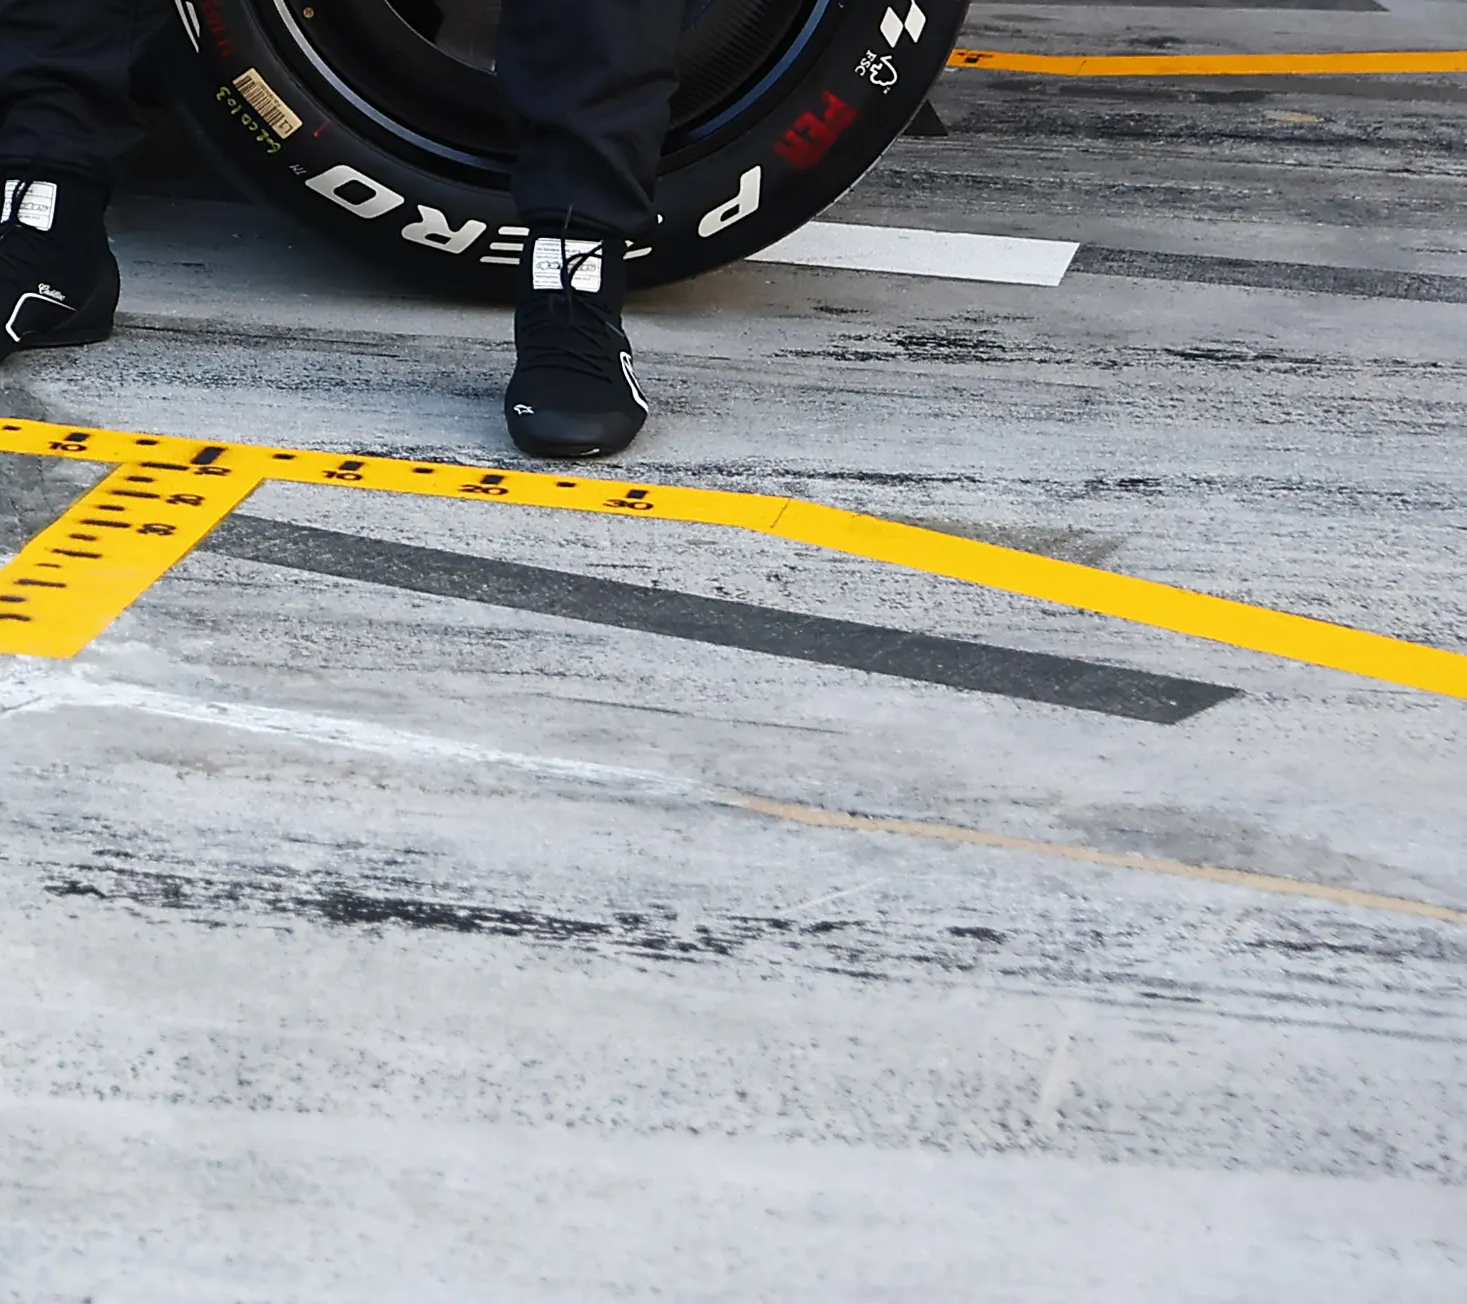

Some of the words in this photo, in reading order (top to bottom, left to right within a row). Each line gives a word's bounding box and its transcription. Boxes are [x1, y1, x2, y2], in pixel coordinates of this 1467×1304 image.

[855, 50, 877, 76] FSC
[48, 440, 88, 453] 10
[321, 469, 364, 482] 10
[458, 483, 509, 496] 20
[602, 498, 654, 511] 30
